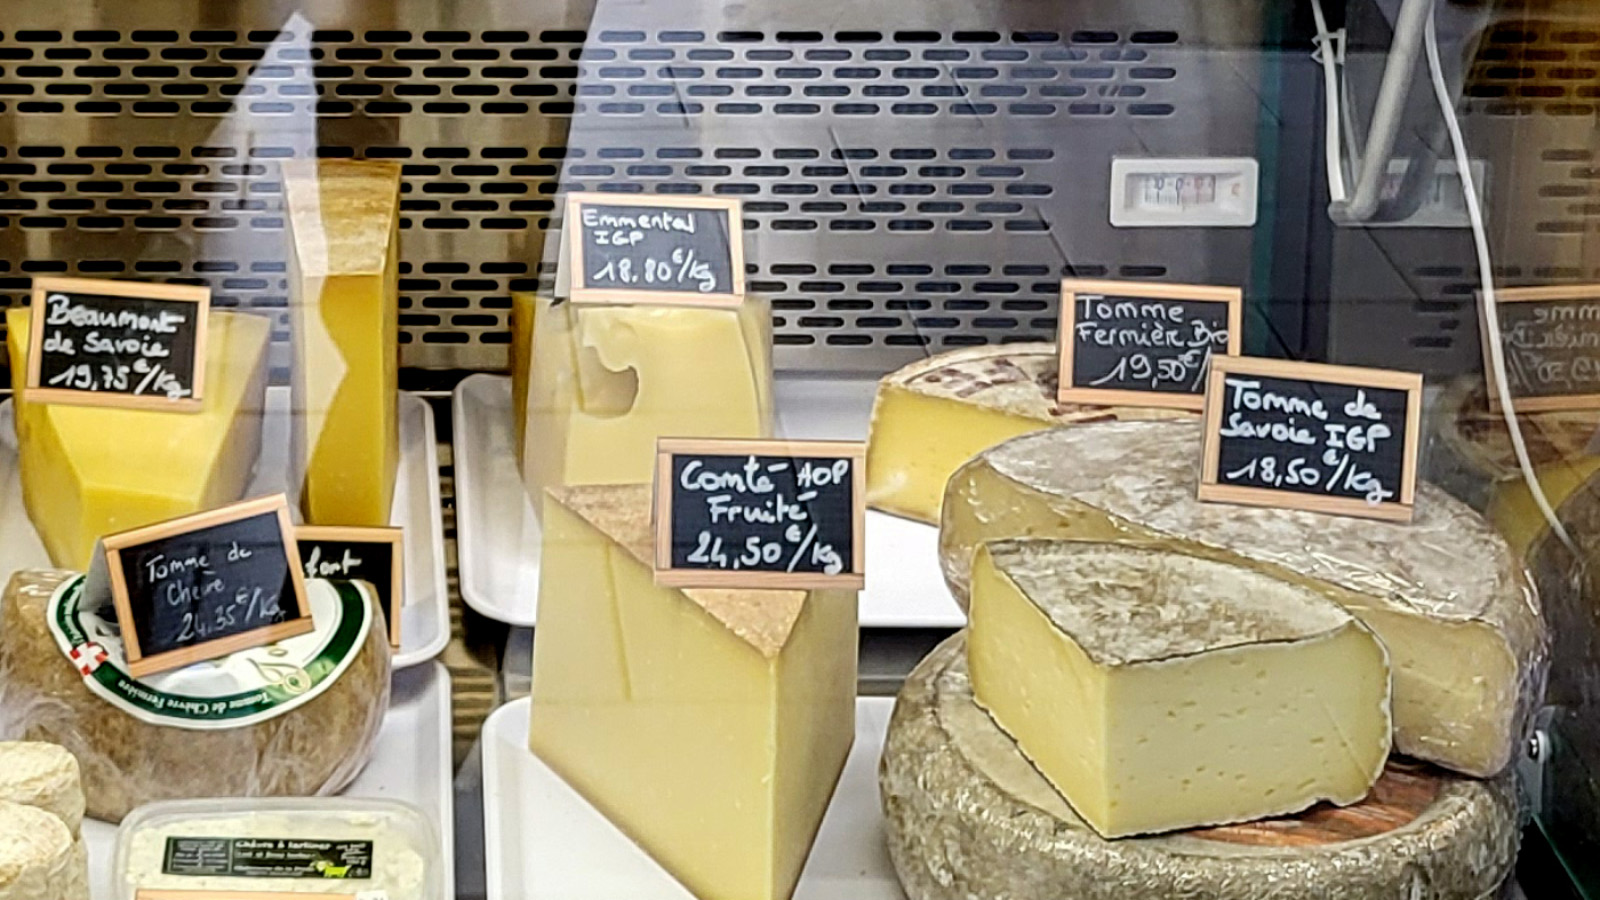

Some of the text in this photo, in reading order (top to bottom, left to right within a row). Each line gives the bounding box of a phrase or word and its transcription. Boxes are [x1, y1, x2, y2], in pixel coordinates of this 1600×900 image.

[582, 208, 695, 234] Emmental
[594, 230, 644, 246] IGP
[47, 294, 186, 333] Beaumont
[1076, 295, 1185, 322] Tomme
[44, 330, 169, 357] de Savoie
[1089, 345, 1212, 392] 19,50€/
[1225, 378, 1382, 420] Tomme de
[1219, 412, 1392, 452] Savoie IGP
[680, 455, 849, 493] Comté AOP
[706, 490, 818, 524] Fruité
[146, 541, 253, 584] Tomme de
[211, 700, 228, 714] de
